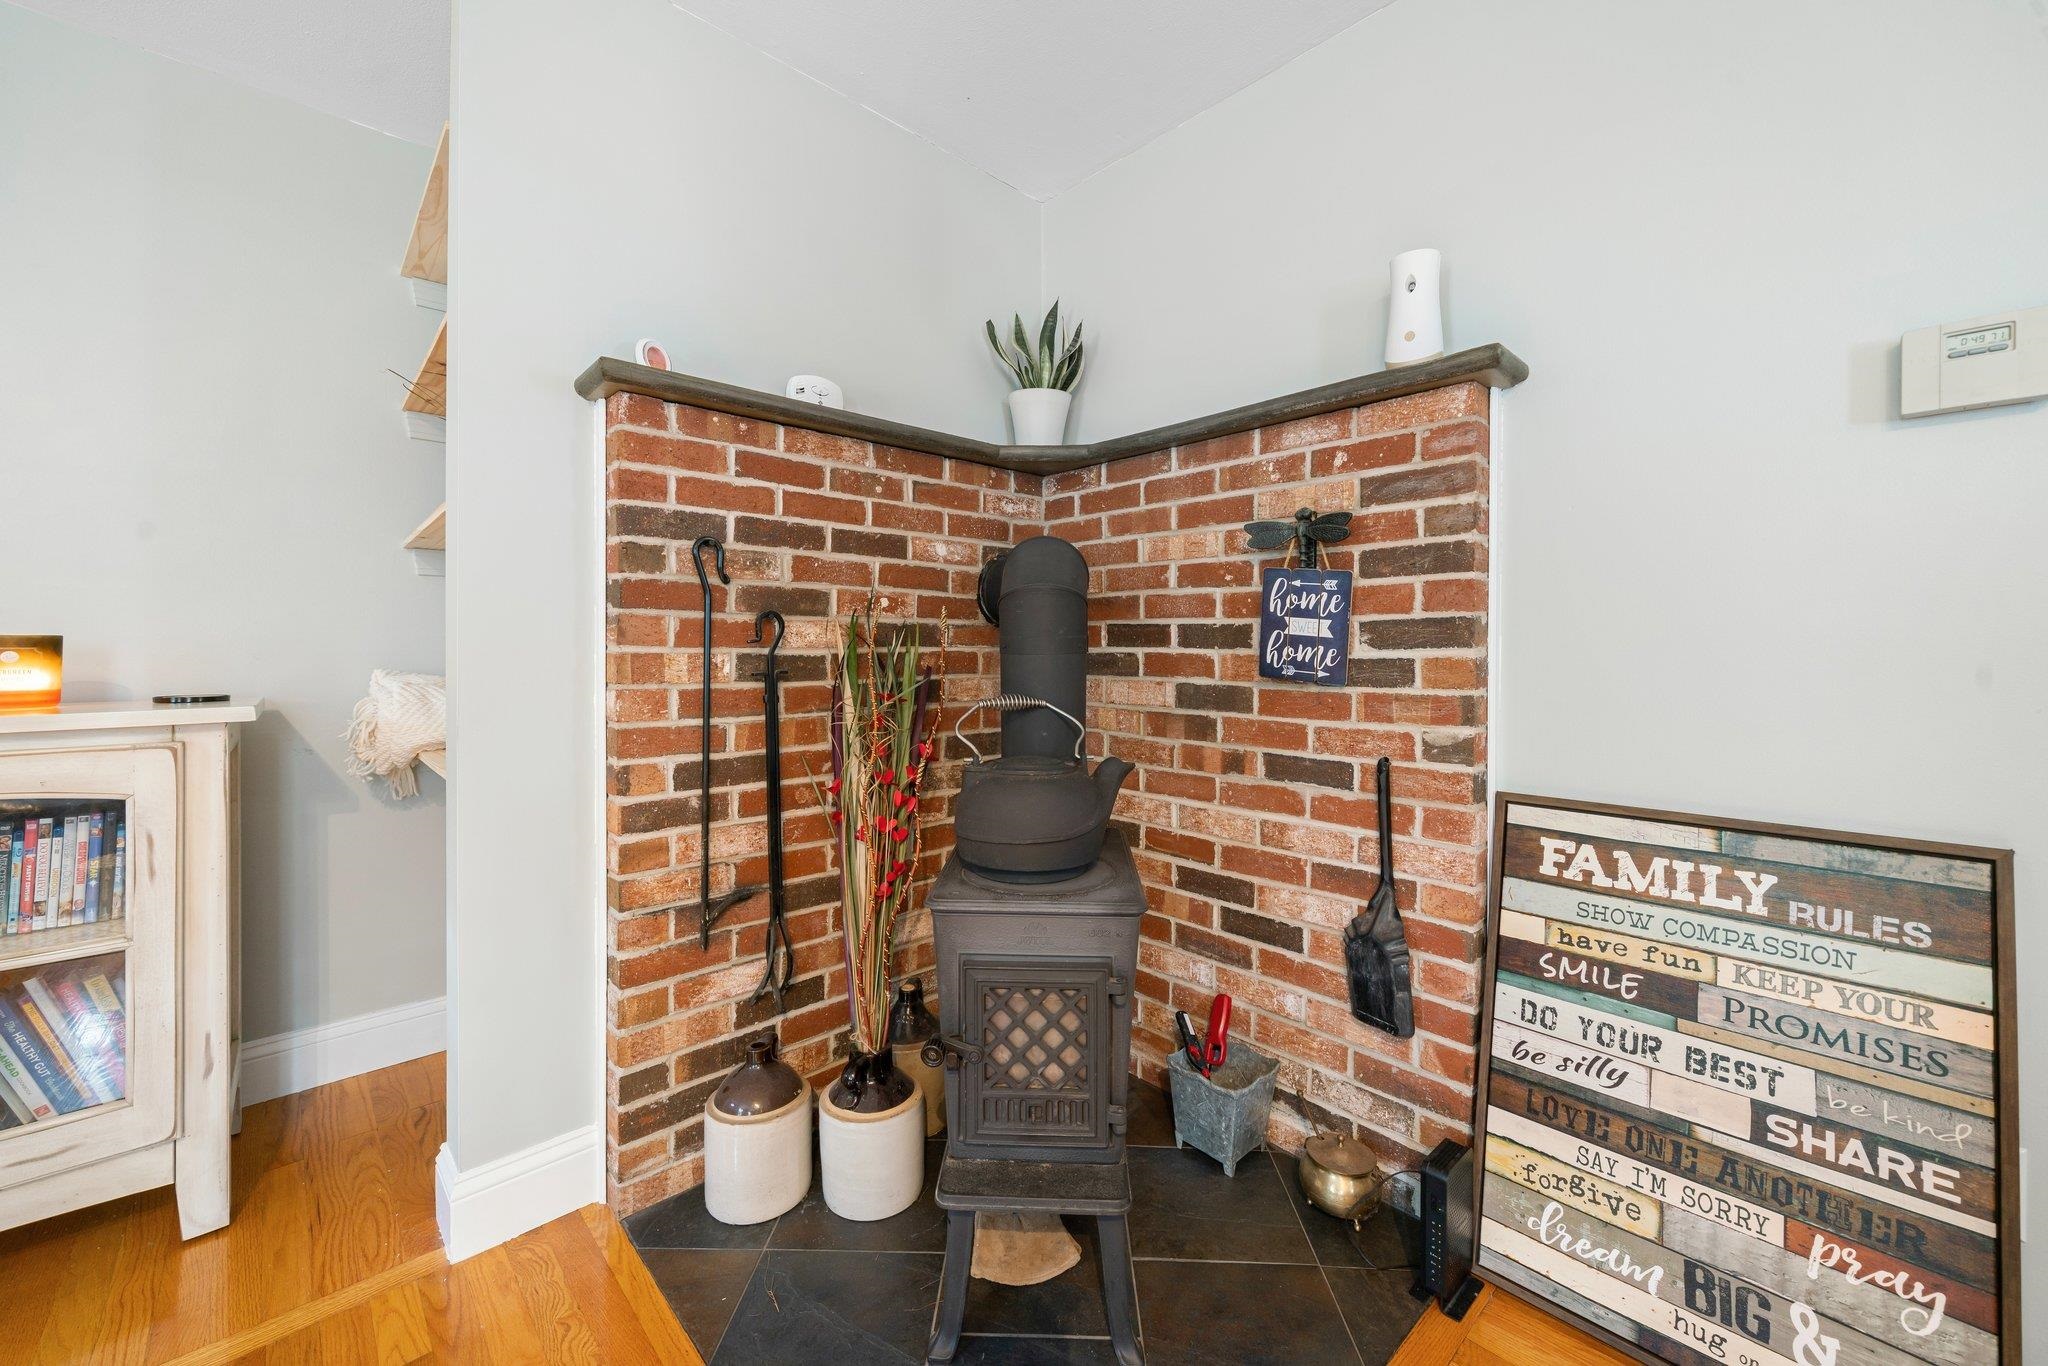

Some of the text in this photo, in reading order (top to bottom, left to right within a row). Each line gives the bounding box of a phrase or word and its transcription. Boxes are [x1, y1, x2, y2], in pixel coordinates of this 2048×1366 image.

[1269, 577, 1345, 617] home
[1266, 629, 1341, 670] home
[1539, 835, 1933, 949] FAMILY RULES
[1557, 927, 1703, 973] have fun
[1576, 901, 1857, 970] SHOW COMPASSION
[1538, 952, 1644, 999] SMILE
[1731, 963, 1939, 1032] KEEP YOUR
[12, 1031, 41, 1063] HEALTHY
[34, 1062, 51, 1078] GUT
[1511, 1039, 1631, 1088] be silly
[1519, 998, 1785, 1097] DO YOUR BEST
[1721, 996, 1950, 1079] PROMISES
[1826, 1084, 1974, 1150] be kind
[1525, 1088, 1928, 1257] LOVE ONE ANOTHER
[1576, 1145, 1773, 1238] SAY I'M SORRY
[1765, 1112, 1962, 1205] SHARE
[1520, 1162, 1643, 1223] forgive
[1527, 1200, 1665, 1299] dream
[1682, 1257, 1772, 1346] BIG
[1806, 1233, 1947, 1336] pray
[1672, 1308, 1728, 1358] hug
[1790, 1300, 1842, 1366] &
